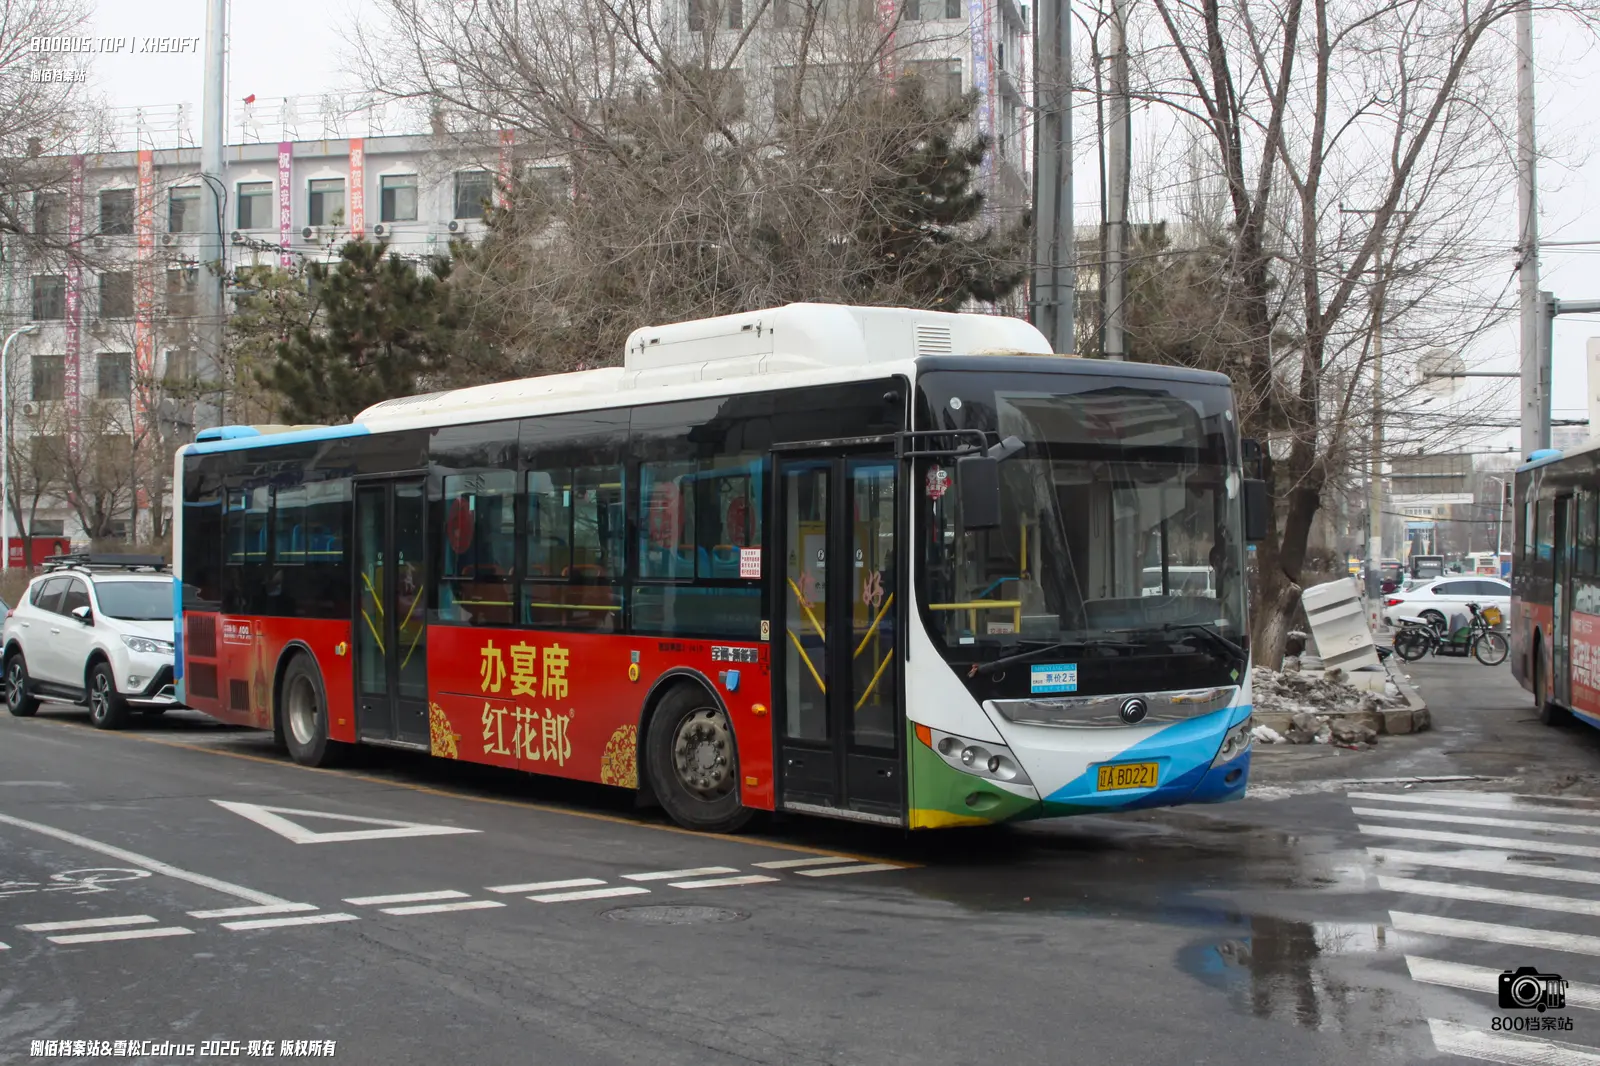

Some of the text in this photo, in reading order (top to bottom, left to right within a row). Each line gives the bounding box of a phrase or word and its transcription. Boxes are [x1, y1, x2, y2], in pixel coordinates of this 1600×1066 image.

[351, 148, 364, 239] 祝贺我校
[480, 639, 569, 700] 办宴席
[1046, 673, 1076, 683] 票价2元
[481, 701, 572, 767] 红花郎
